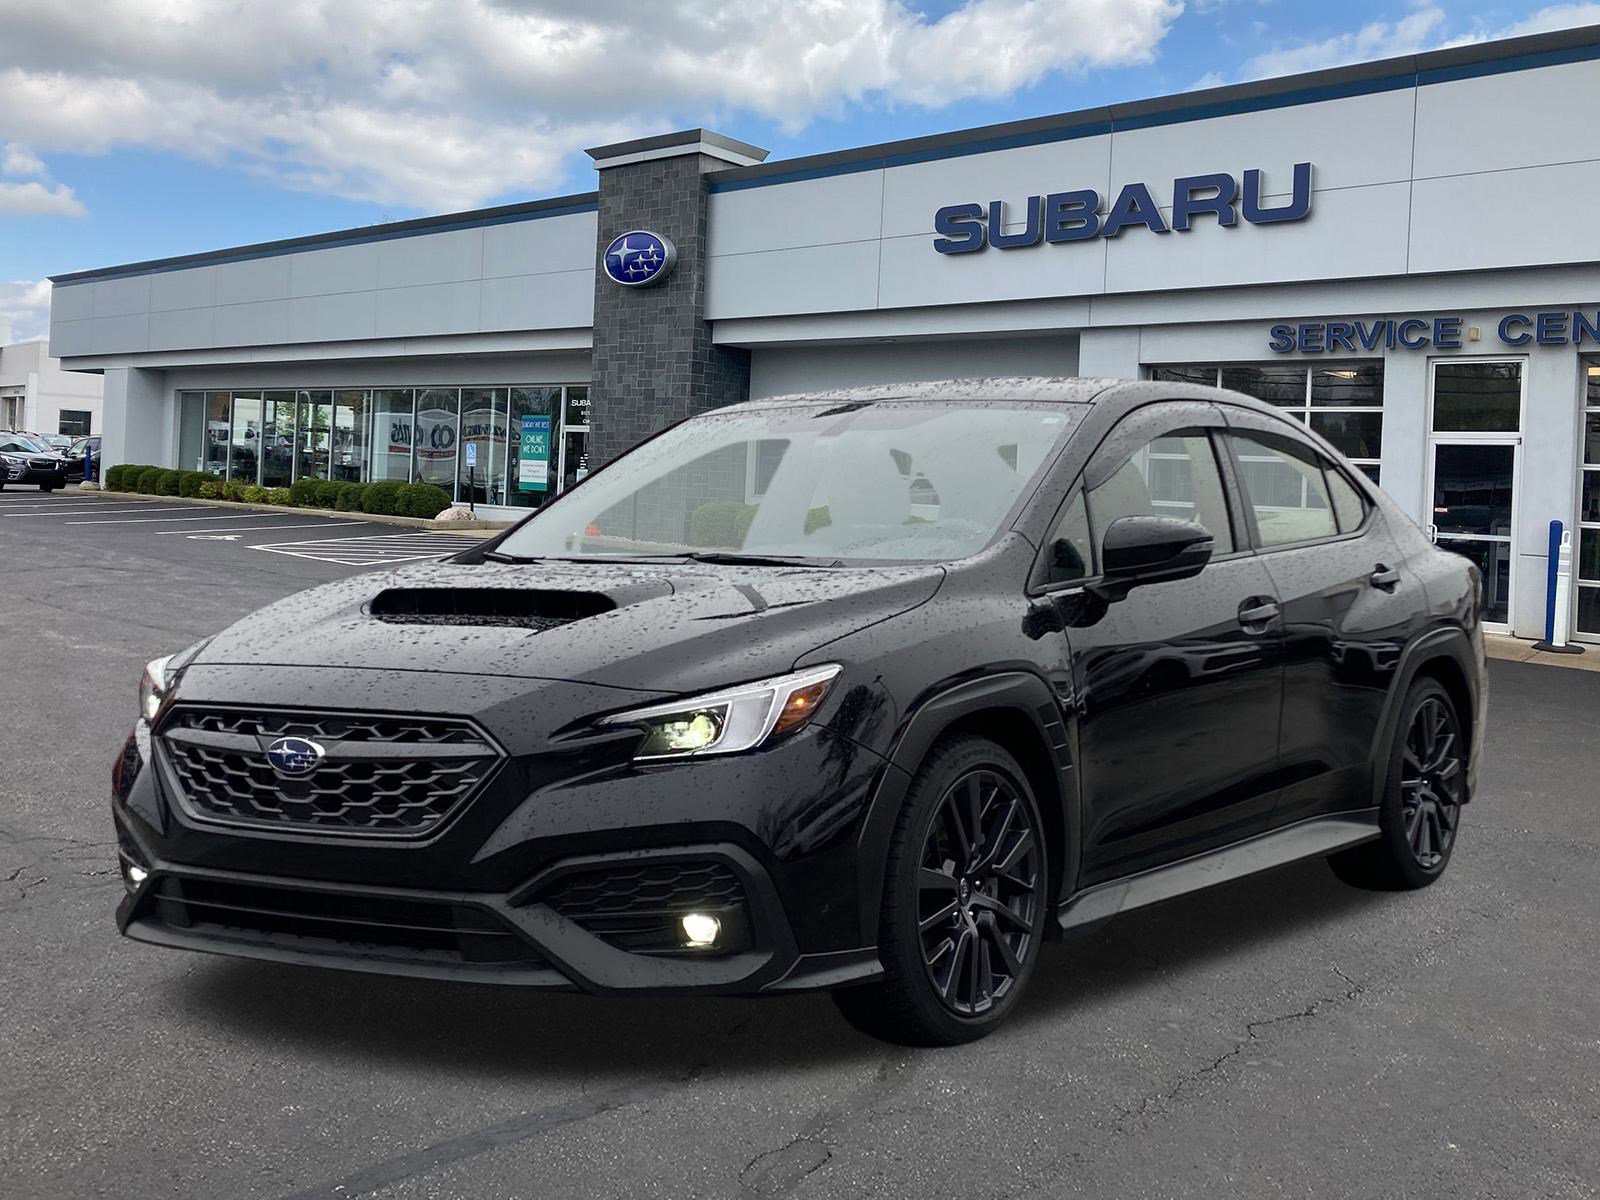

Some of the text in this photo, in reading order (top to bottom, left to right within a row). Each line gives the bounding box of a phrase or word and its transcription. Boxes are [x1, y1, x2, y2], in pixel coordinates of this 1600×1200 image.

[933, 162, 1313, 255] SUBARU
[1268, 311, 1600, 353] SERVICE CEN
[571, 399, 591, 407] SUBA
